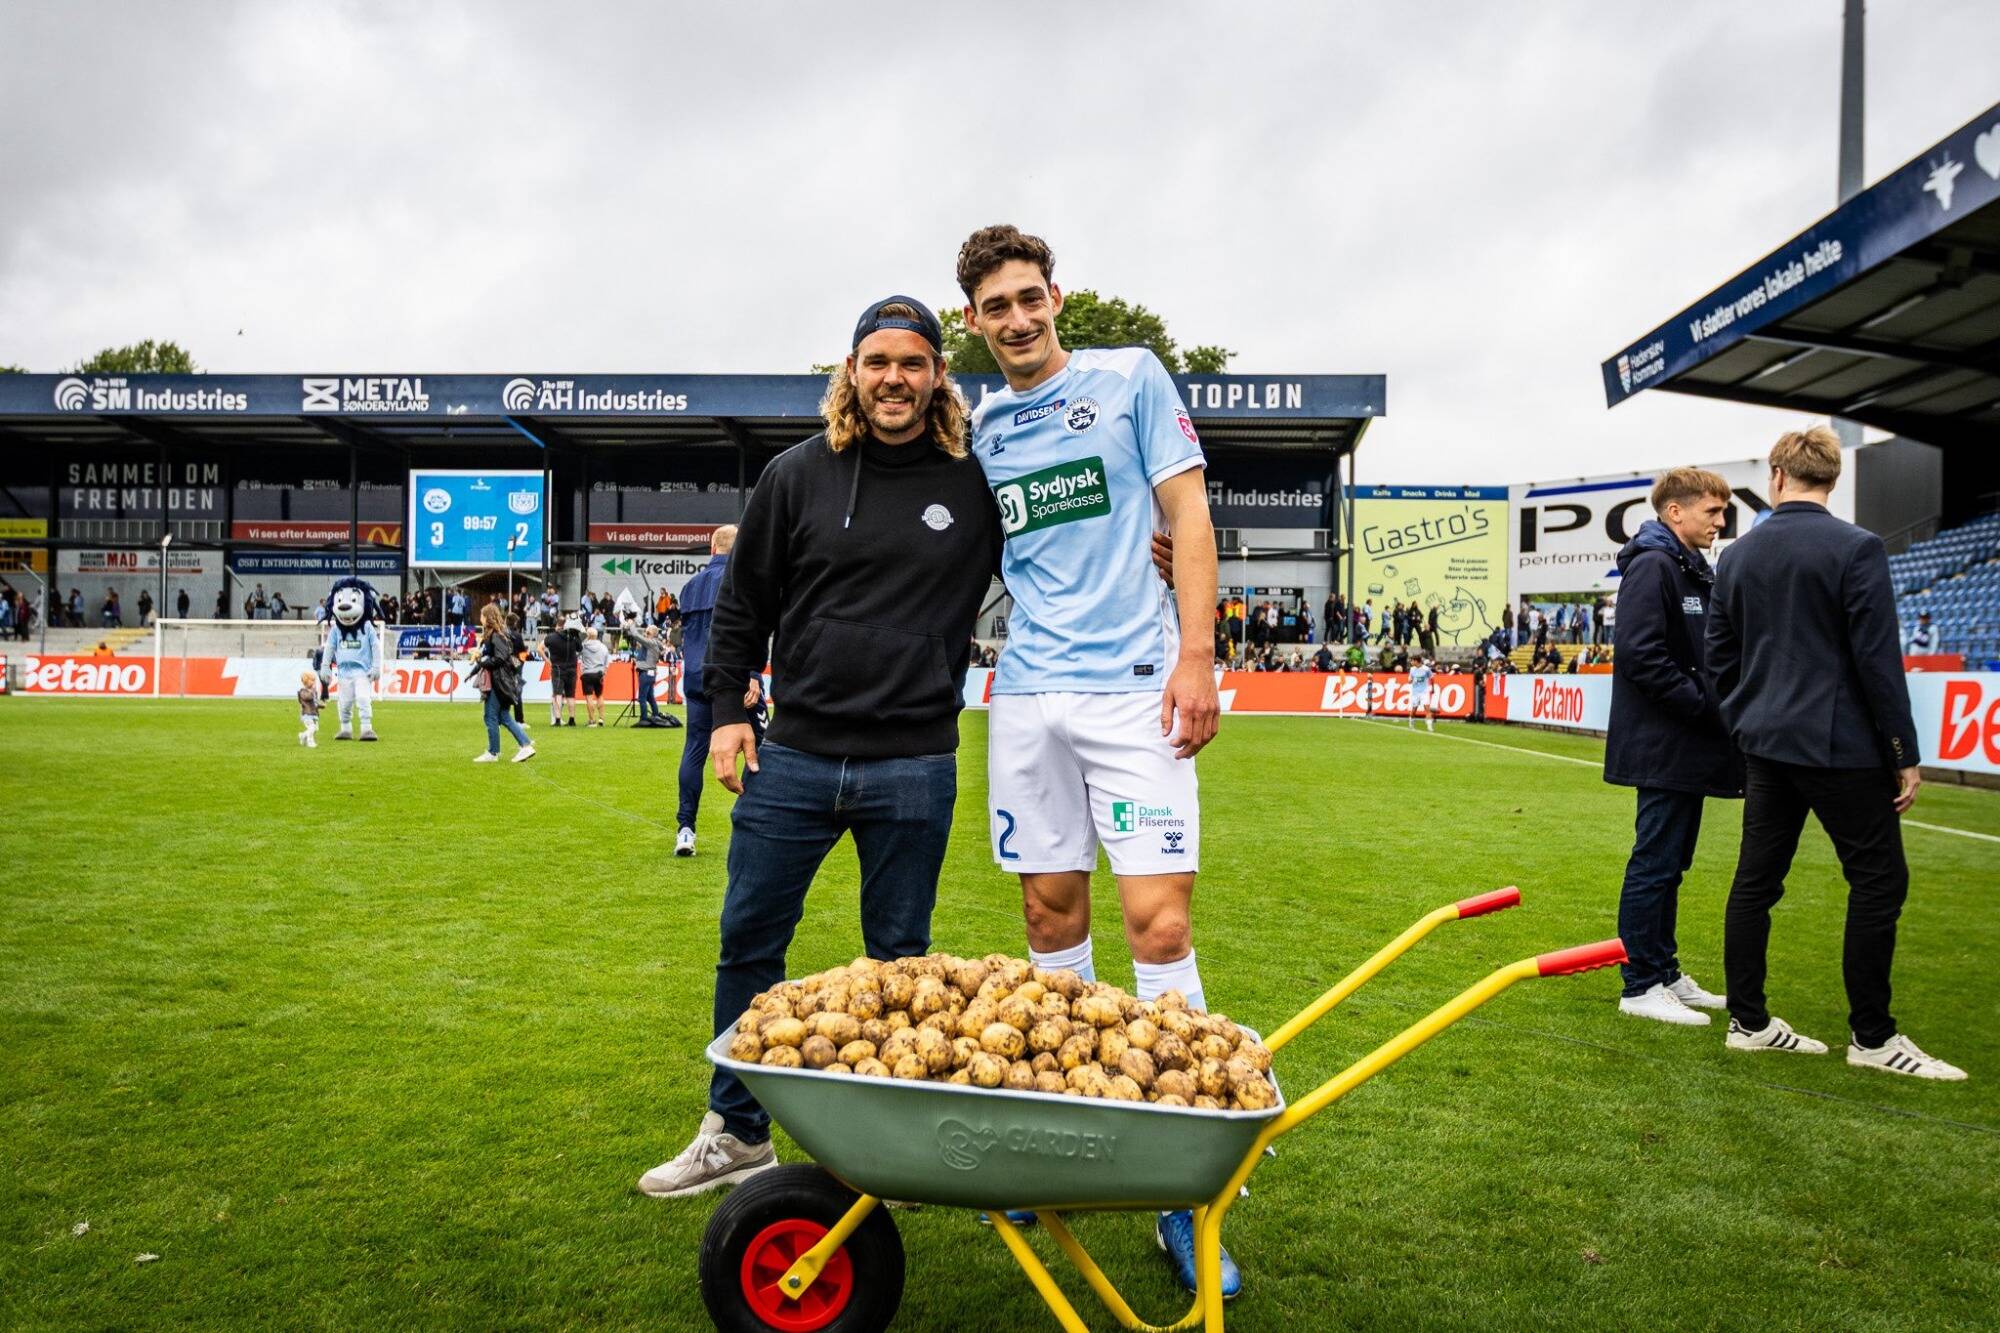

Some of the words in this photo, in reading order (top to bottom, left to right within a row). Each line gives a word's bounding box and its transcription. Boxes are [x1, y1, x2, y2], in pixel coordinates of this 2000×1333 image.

[1735, 285, 1767, 318] vores
[1764, 260, 1805, 300] lokale
[1803, 239, 1842, 278] helte
[136, 388, 247, 411] Industries
[343, 378, 429, 401] METAL
[578, 389, 688, 411] Industries
[1187, 383, 1302, 409] TOPLØN
[1017, 404, 1056, 424] DAVIDSEN
[186, 463, 219, 484] OM
[1029, 468, 1101, 502] Sydjysk
[74, 488, 213, 510] FREMTIDEN
[1031, 493, 1104, 519] Sparekasse
[1227, 489, 1323, 507] Industries
[249, 529, 260, 539] Vi
[261, 531, 278, 539] ses
[280, 529, 304, 540] efter
[306, 529, 350, 541] kampen!
[430, 521, 444, 546] 3
[515, 522, 529, 546] 2
[607, 532, 617, 541] Vi
[638, 532, 664, 541] efter
[665, 532, 710, 543] kampen!
[1363, 505, 1489, 554] Gastro's
[106, 552, 138, 567] MAD
[1532, 677, 1584, 723] Betano
[1138, 816, 1185, 827] Fliserens
[1139, 806, 1173, 816] Dansk
[996, 808, 1019, 859] 2
[1006, 1125, 1117, 1161] GARDEN
